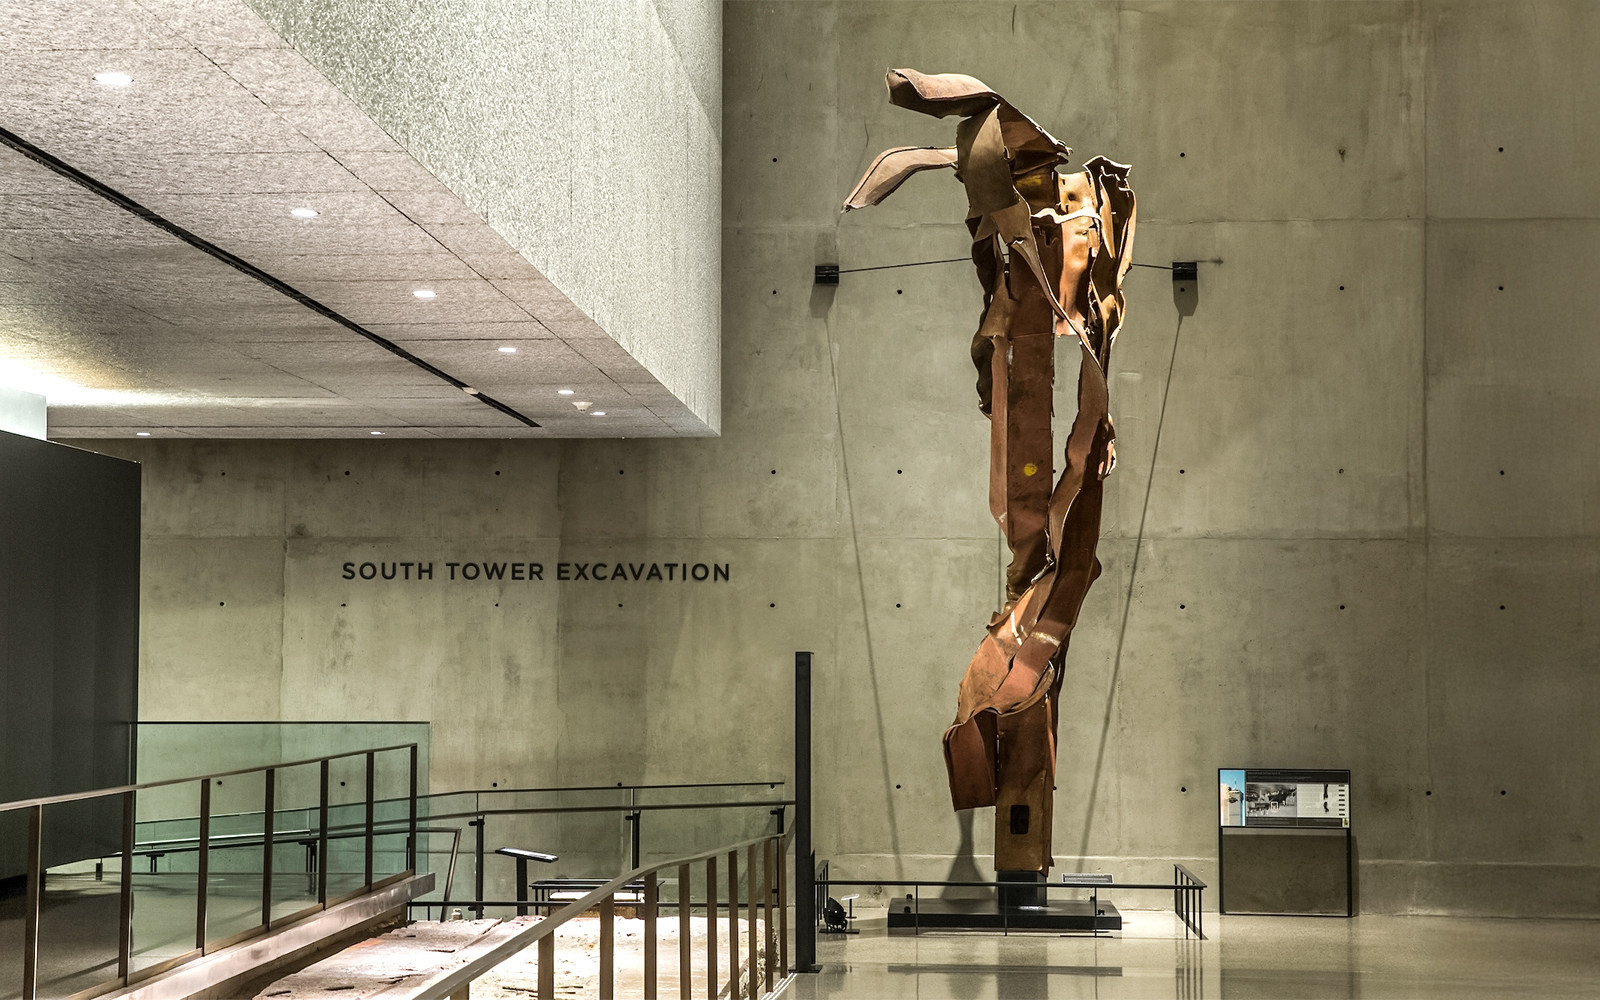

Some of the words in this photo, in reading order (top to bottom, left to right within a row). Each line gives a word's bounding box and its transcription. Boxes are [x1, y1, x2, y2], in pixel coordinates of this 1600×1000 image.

[342, 562, 433, 580] SOUTH
[446, 562, 544, 581] TOWER
[556, 562, 730, 582] EXCAVATION
